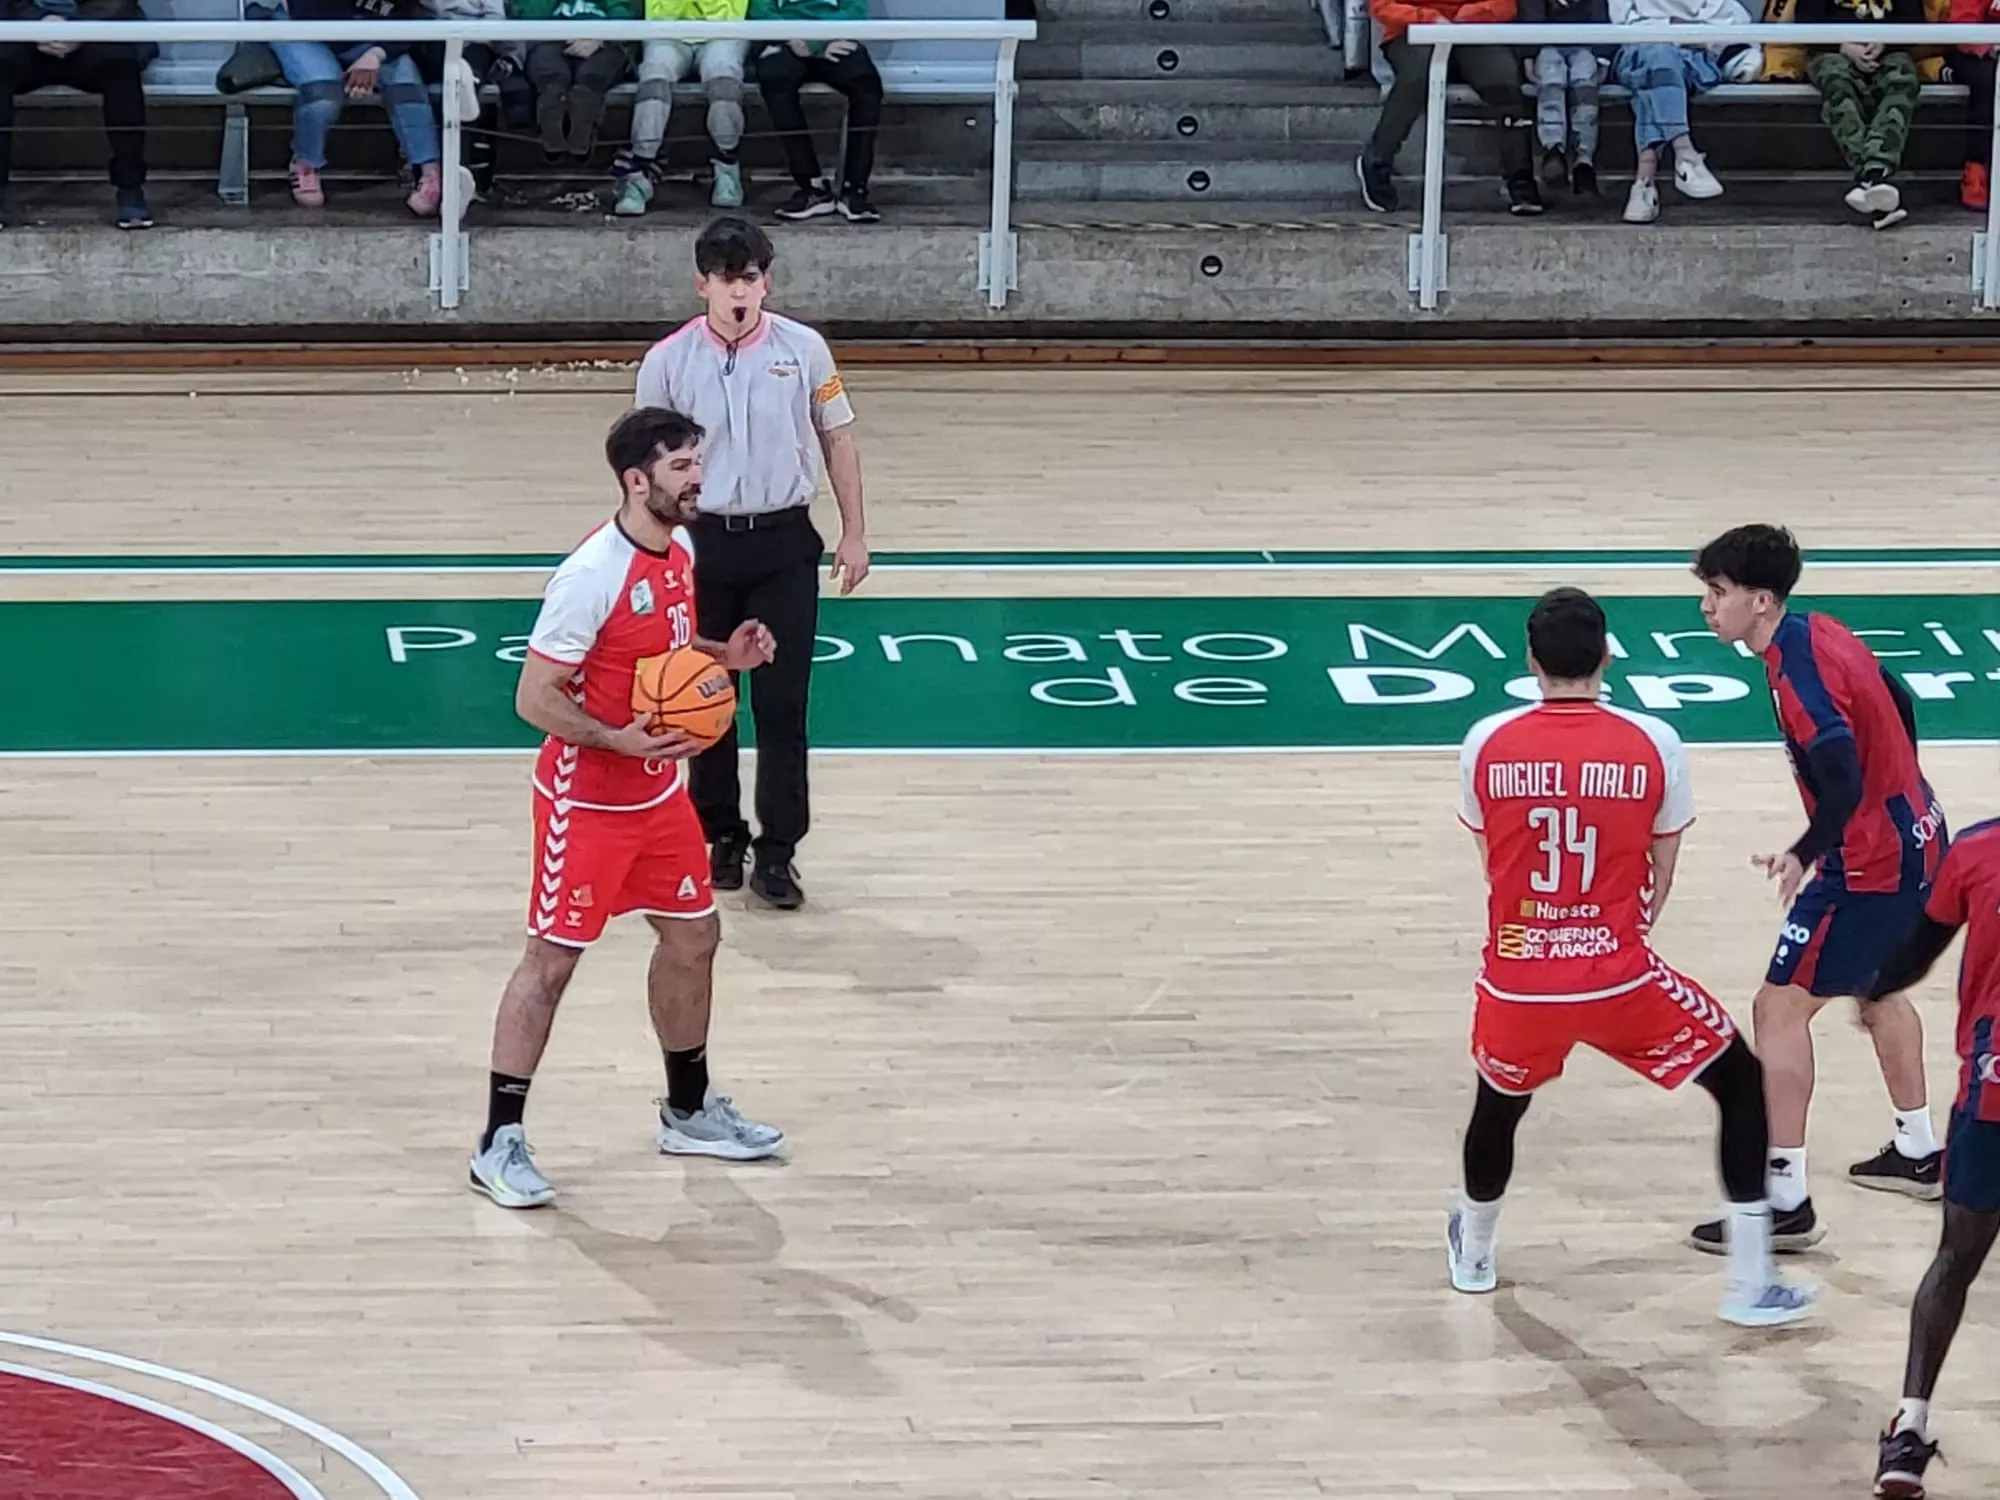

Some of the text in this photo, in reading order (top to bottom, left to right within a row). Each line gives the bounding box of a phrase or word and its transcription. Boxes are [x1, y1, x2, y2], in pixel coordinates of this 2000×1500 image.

[667, 602, 691, 651] 36
[1030, 666, 1269, 706] de
[1488, 761, 1648, 800] MIGUEL MALO
[1528, 806, 1598, 894] 34
[1536, 900, 1601, 920] Huesca
[1523, 944, 1545, 959] DE
[1526, 926, 1611, 943] GOBIERNO
